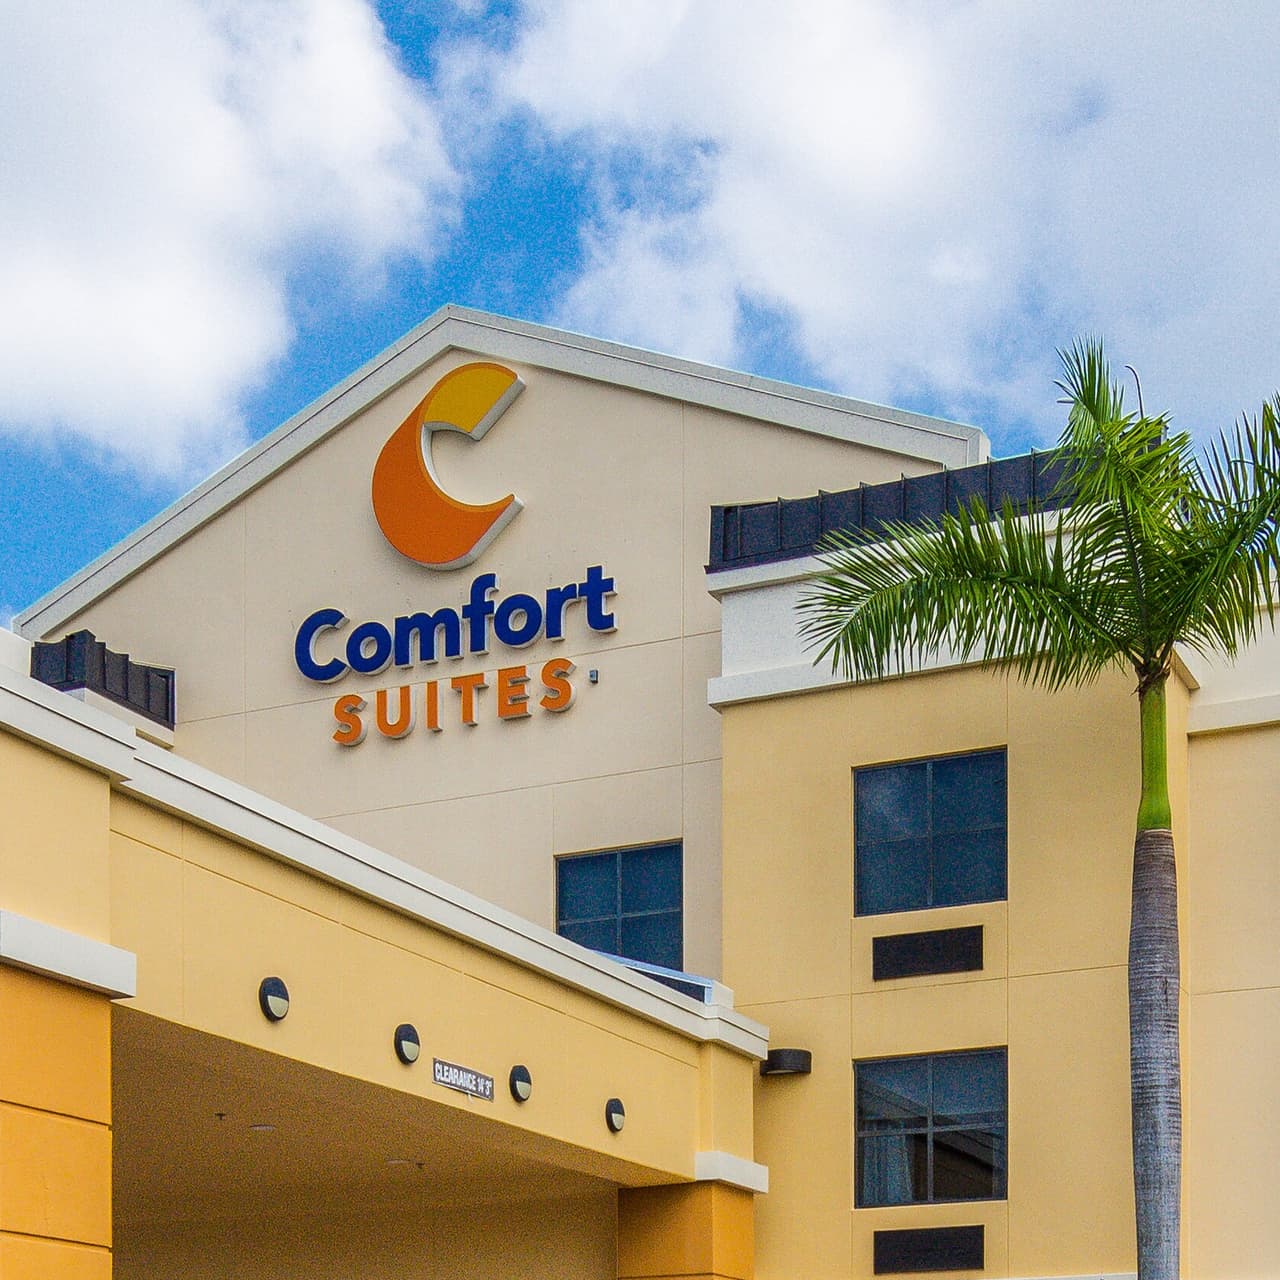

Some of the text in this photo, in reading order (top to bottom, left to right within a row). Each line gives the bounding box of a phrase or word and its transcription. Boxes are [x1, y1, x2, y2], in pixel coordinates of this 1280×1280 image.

[294, 565, 618, 683] Comfort
[332, 658, 577, 746] SUITES
[435, 1062, 476, 1090] CLEARANCE
